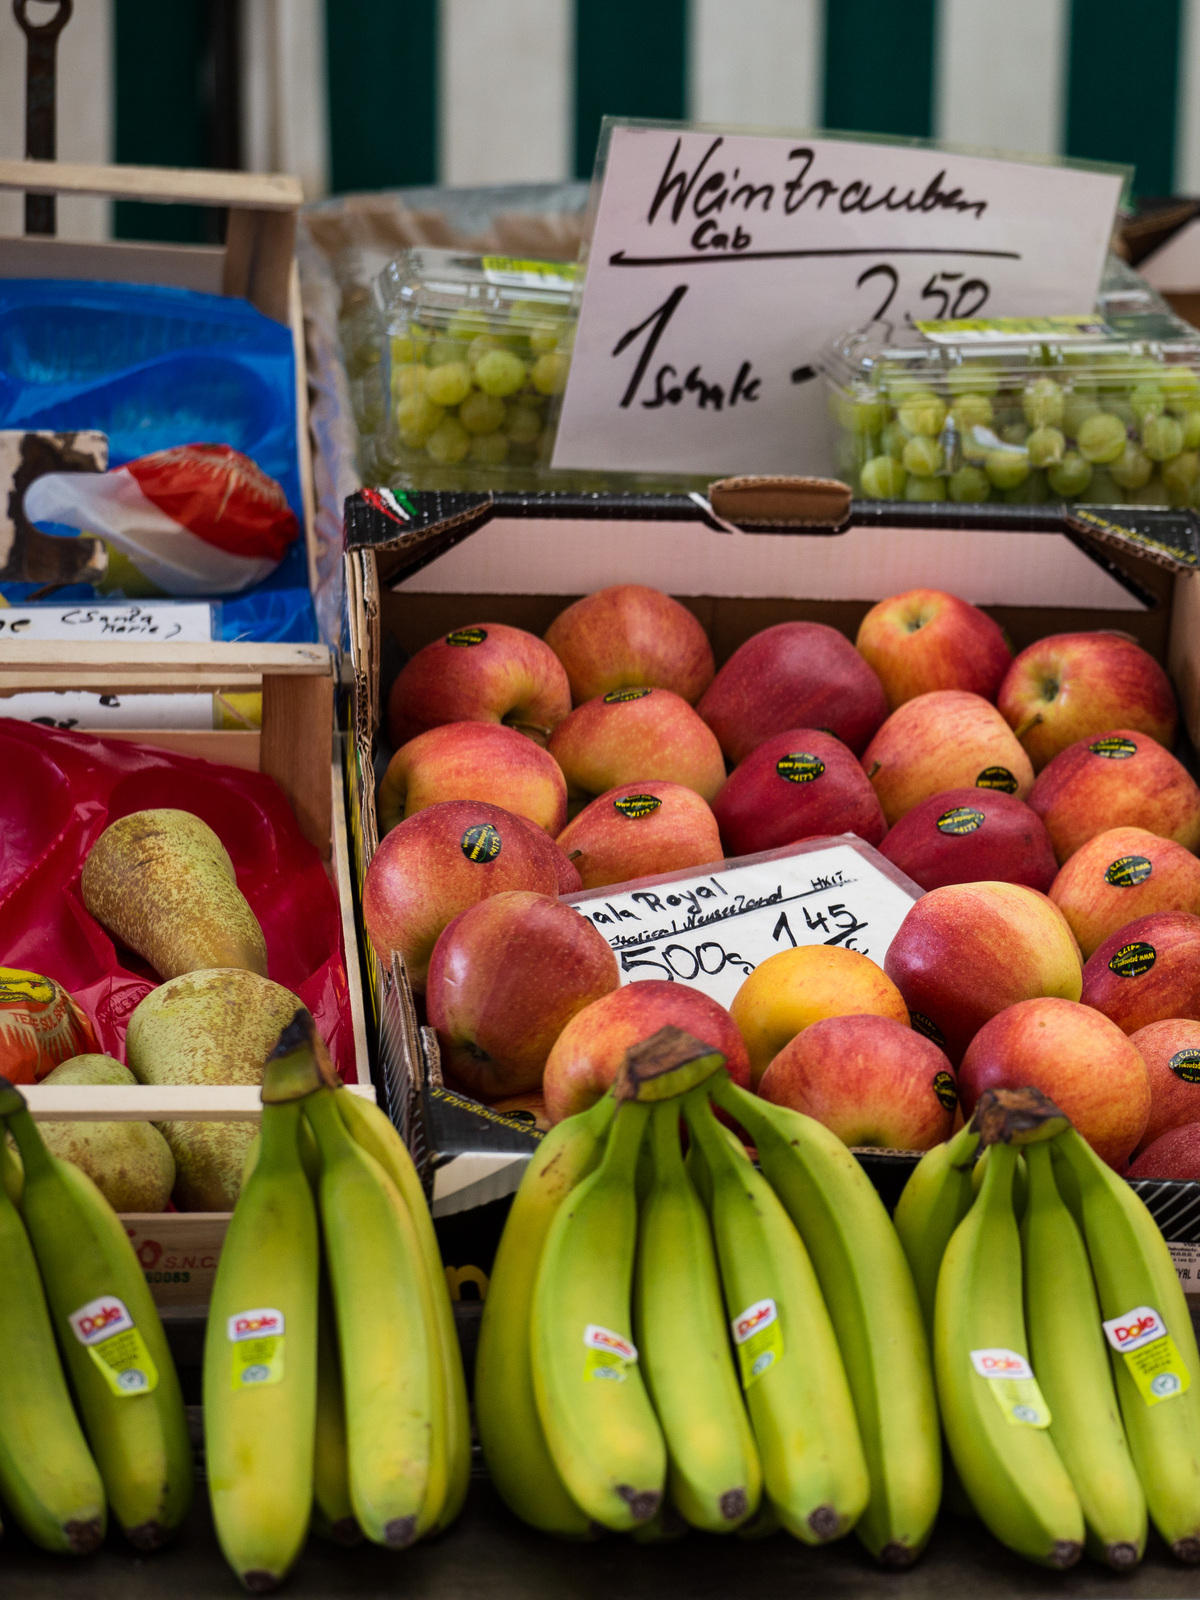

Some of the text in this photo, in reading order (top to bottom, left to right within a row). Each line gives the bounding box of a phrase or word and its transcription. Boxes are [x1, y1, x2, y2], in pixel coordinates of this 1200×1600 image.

[631, 877, 728, 915] Royal
[1176, 1268, 1191, 1279] YAL
[79, 1305, 122, 1334] Dole
[235, 1315, 278, 1332] Dole
[738, 1307, 771, 1336] Dole
[1113, 1315, 1155, 1343] Dole
[981, 1356, 1022, 1370] Dole
